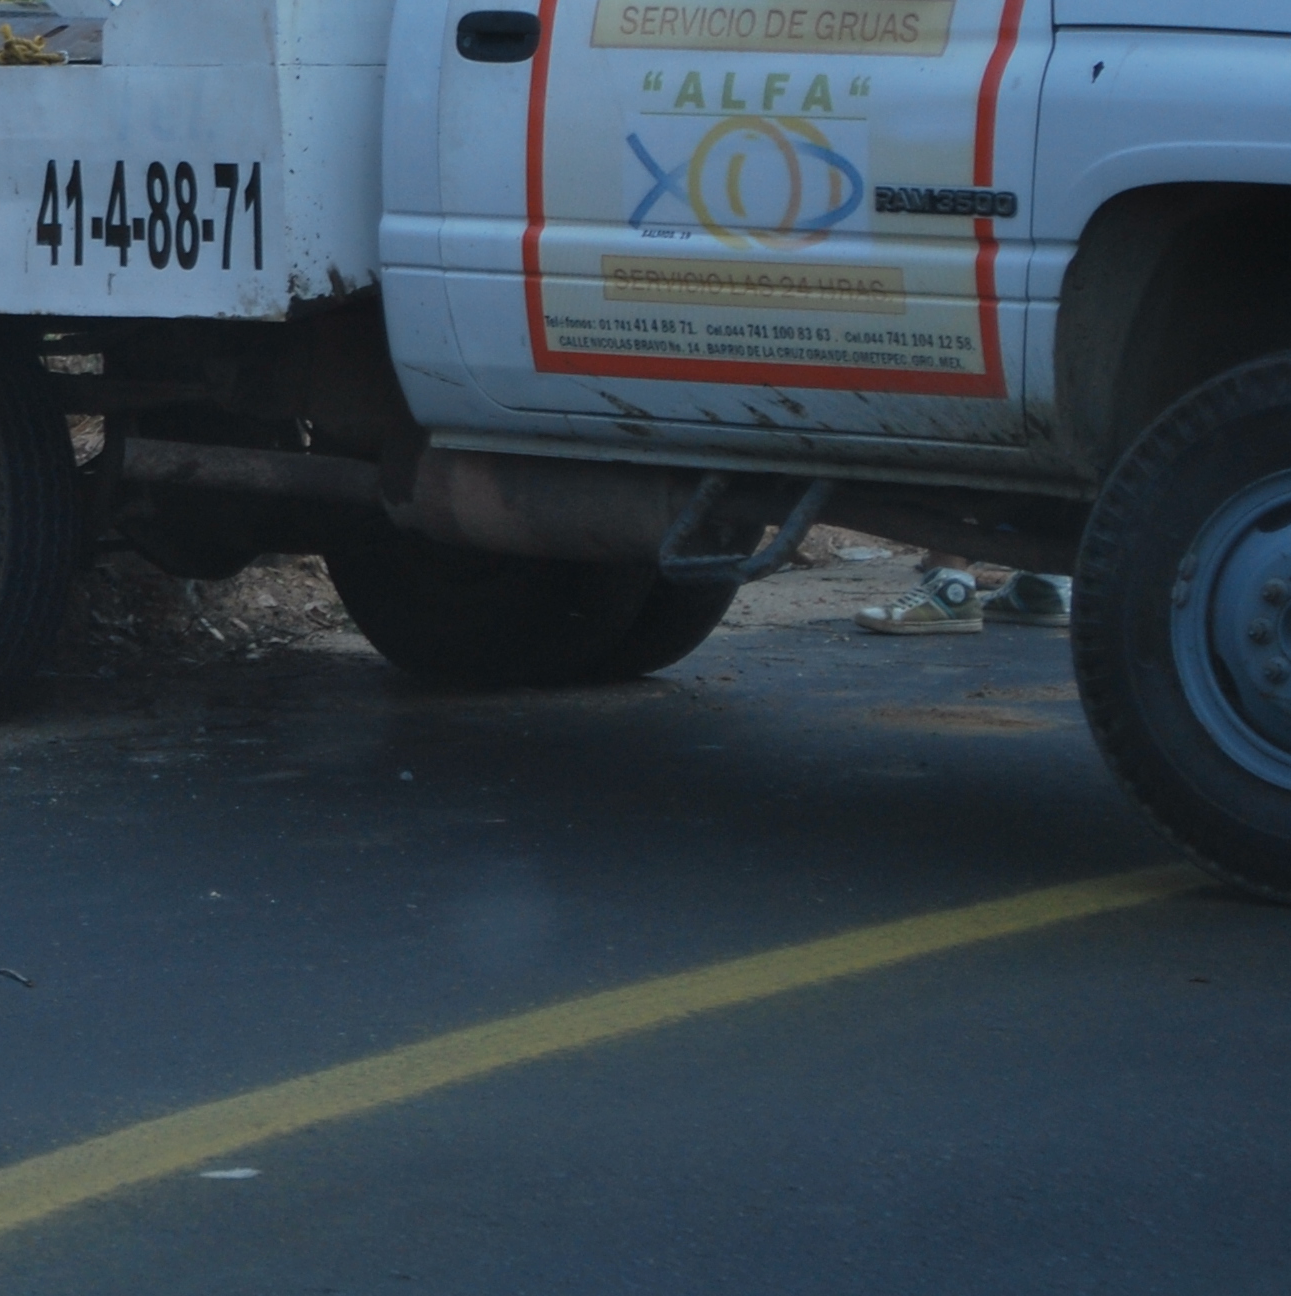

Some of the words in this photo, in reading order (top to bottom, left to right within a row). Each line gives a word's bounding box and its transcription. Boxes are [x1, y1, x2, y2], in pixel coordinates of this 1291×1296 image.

[619, 5, 757, 38] SERVICIO
[763, 9, 809, 40] DE
[814, 11, 920, 44] GRUAS
[36, 159, 264, 271] 41-4-88-71
[874, 185, 934, 214] RAM
[934, 188, 1018, 218] 3500
[612, 267, 720, 297] SERVICIO
[730, 273, 773, 299] LAS
[779, 275, 809, 300] 24
[746, 323, 769, 339] 741
[886, 330, 909, 347] 741
